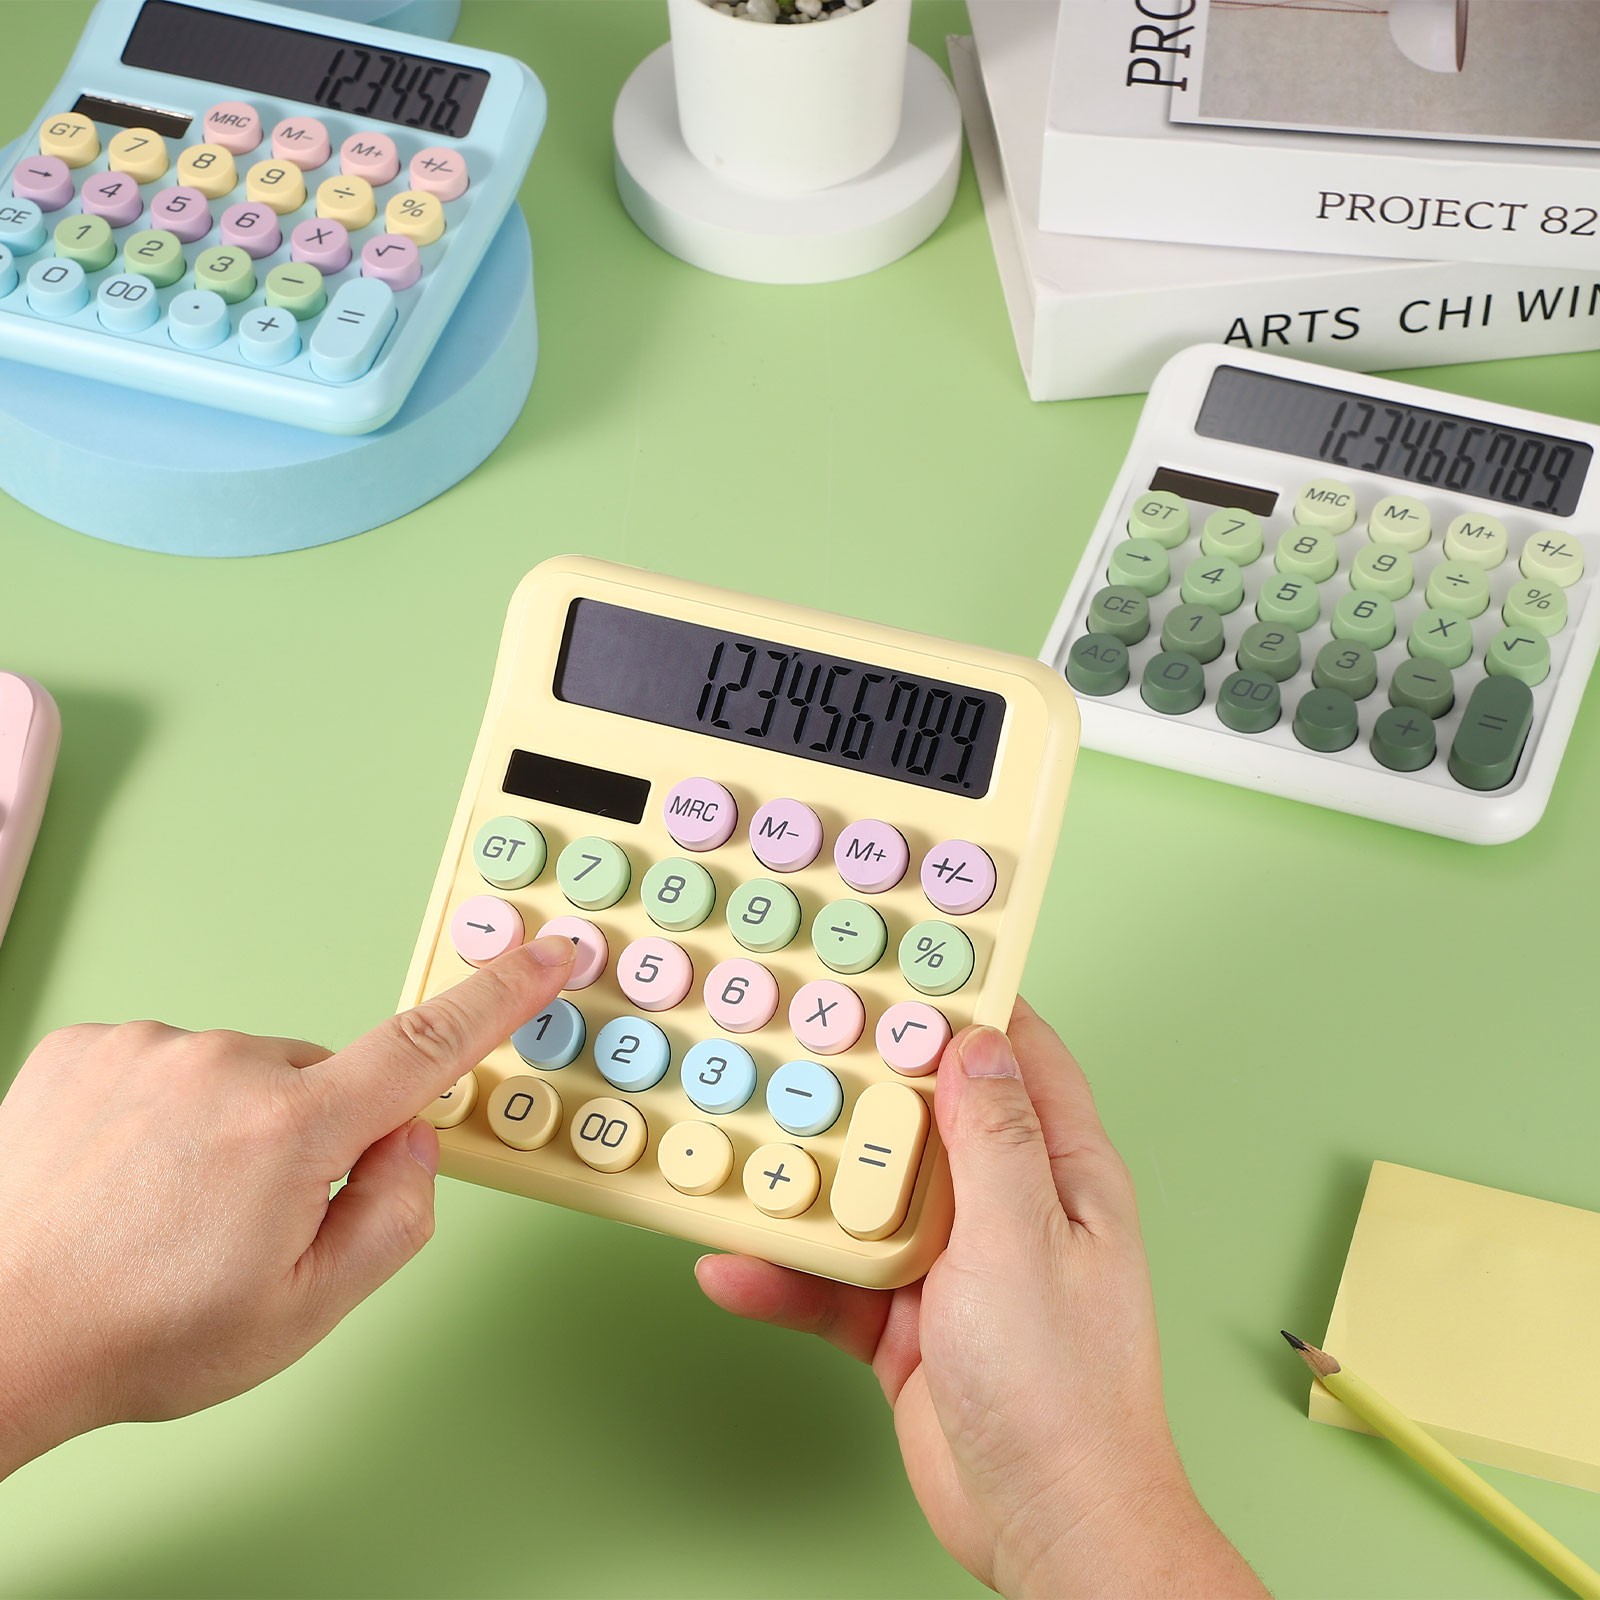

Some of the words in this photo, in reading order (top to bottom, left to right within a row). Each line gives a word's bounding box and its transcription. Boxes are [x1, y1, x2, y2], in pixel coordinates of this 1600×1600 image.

[210, 112, 250, 127] MRC
[351, 143, 381, 157] M+
[49, 123, 85, 137] GT
[125, 138, 149, 152] 7
[193, 154, 216, 168] 8
[260, 169, 285, 184] 9
[400, 200, 425, 217] %
[99, 184, 122, 197] 4
[166, 196, 191, 212] 5
[235, 213, 259, 228] 6
[1317, 192, 1527, 231] PROJECT
[1541, 206, 1597, 235] 82
[0, 207, 32, 225] CE
[77, 225, 91, 239] 1
[138, 241, 163, 256] 2
[210, 256, 234, 272] 3
[42, 267, 68, 282] 0
[106, 280, 146, 302] 00
[1224, 307, 1359, 348] ARTS
[1400, 294, 1492, 333] CHI
[1306, 488, 1350, 506] MRC
[1460, 523, 1494, 538] M+
[1142, 502, 1178, 519] GT
[1222, 520, 1245, 535] 7
[1294, 537, 1317, 553] 8
[1372, 555, 1397, 572] 9
[1525, 589, 1551, 609] %
[1201, 569, 1224, 584] 4
[1277, 583, 1301, 600] 5
[1353, 601, 1377, 618] 6
[1104, 597, 1139, 614] CE
[1190, 616, 1203, 631] 1
[1259, 633, 1284, 651] 2
[1336, 651, 1360, 669] 3
[1080, 645, 1120, 663] AC
[1163, 663, 1189, 680] 0
[1231, 679, 1273, 702] 00
[670, 796, 718, 821] MRC
[846, 839, 886, 861] M+
[483, 836, 525, 861] GT
[574, 854, 601, 881] 7
[658, 876, 685, 903] 8
[742, 897, 771, 924] 9
[915, 937, 946, 968] %
[635, 955, 663, 982] 5
[722, 977, 749, 1004] 6
[536, 1014, 552, 1040] 1
[611, 1036, 639, 1063] 2
[699, 1057, 727, 1085] 3
[504, 1093, 533, 1121] 0
[580, 1113, 627, 1147] 00
